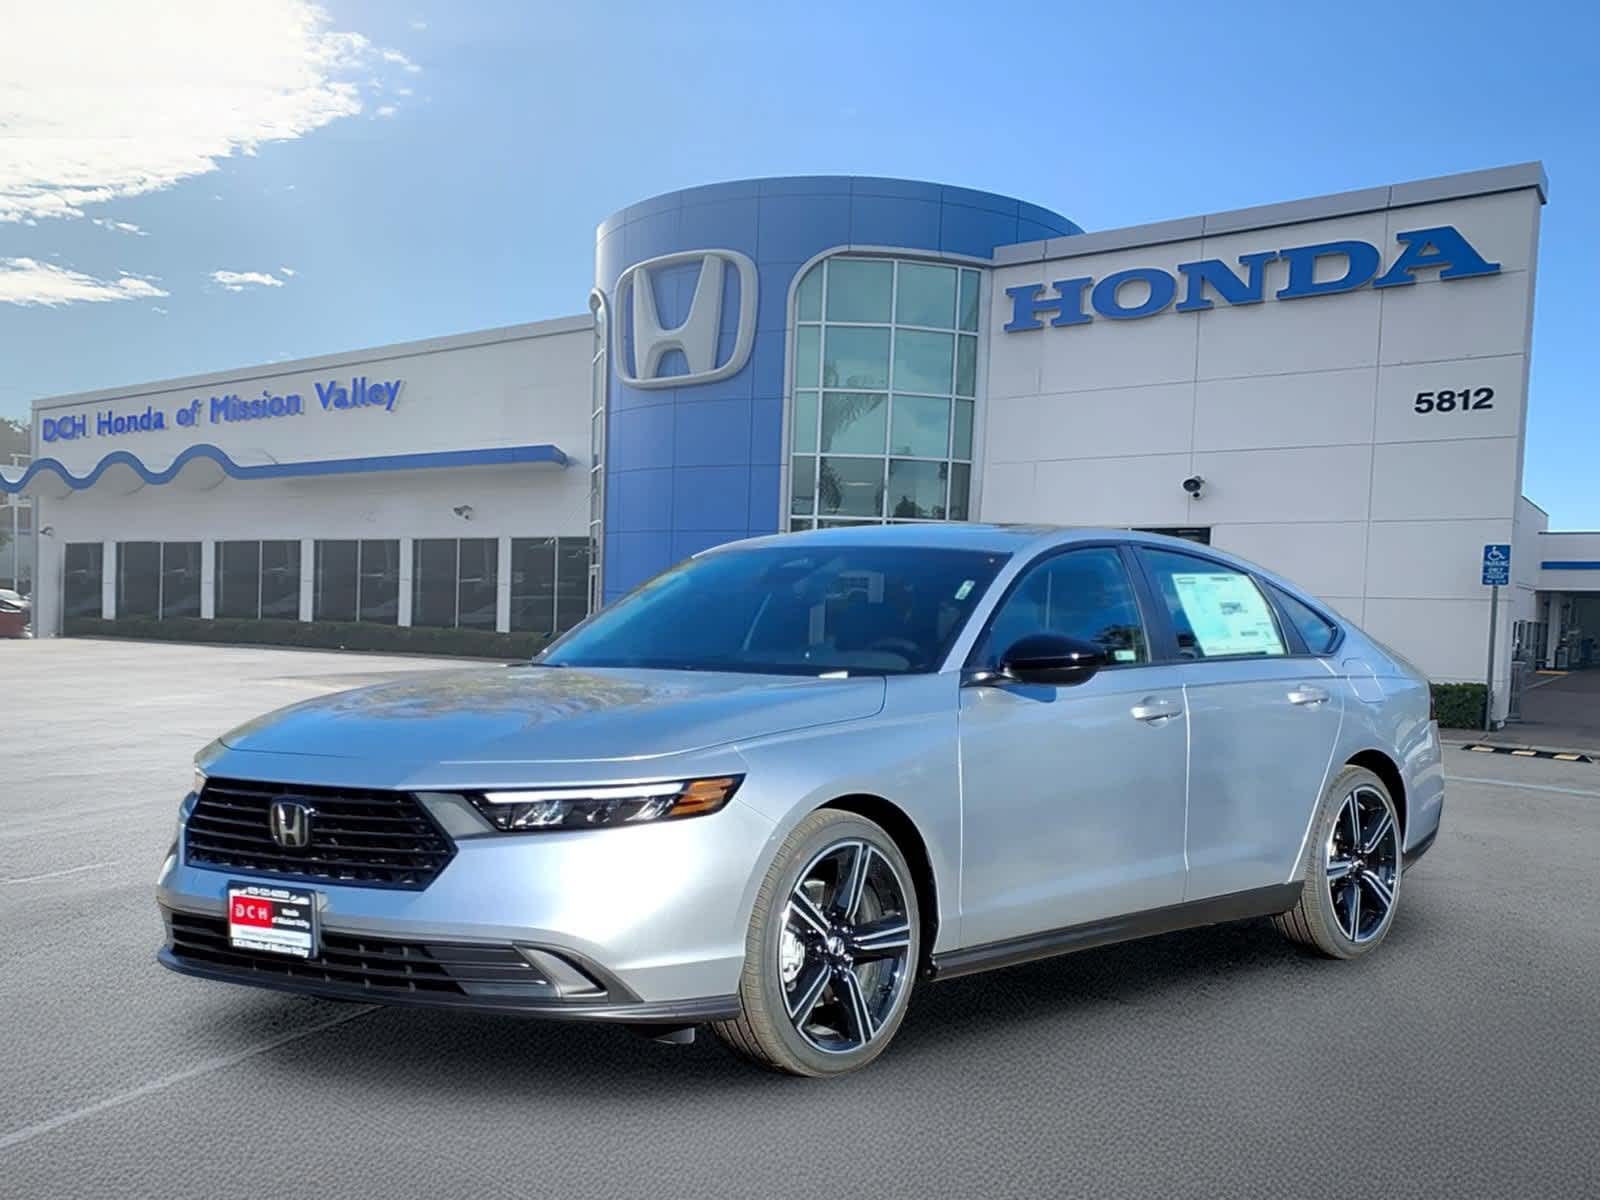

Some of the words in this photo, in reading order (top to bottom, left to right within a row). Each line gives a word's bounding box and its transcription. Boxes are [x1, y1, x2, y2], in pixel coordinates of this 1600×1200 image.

[1003, 225, 1502, 333] HONDA
[42, 413, 87, 443] DCH
[96, 405, 166, 437] Honda
[176, 399, 201, 428] of
[210, 390, 303, 424] Mission
[314, 376, 402, 412] Valley
[1413, 387, 1495, 414] 5812
[235, 903, 269, 921] DCH
